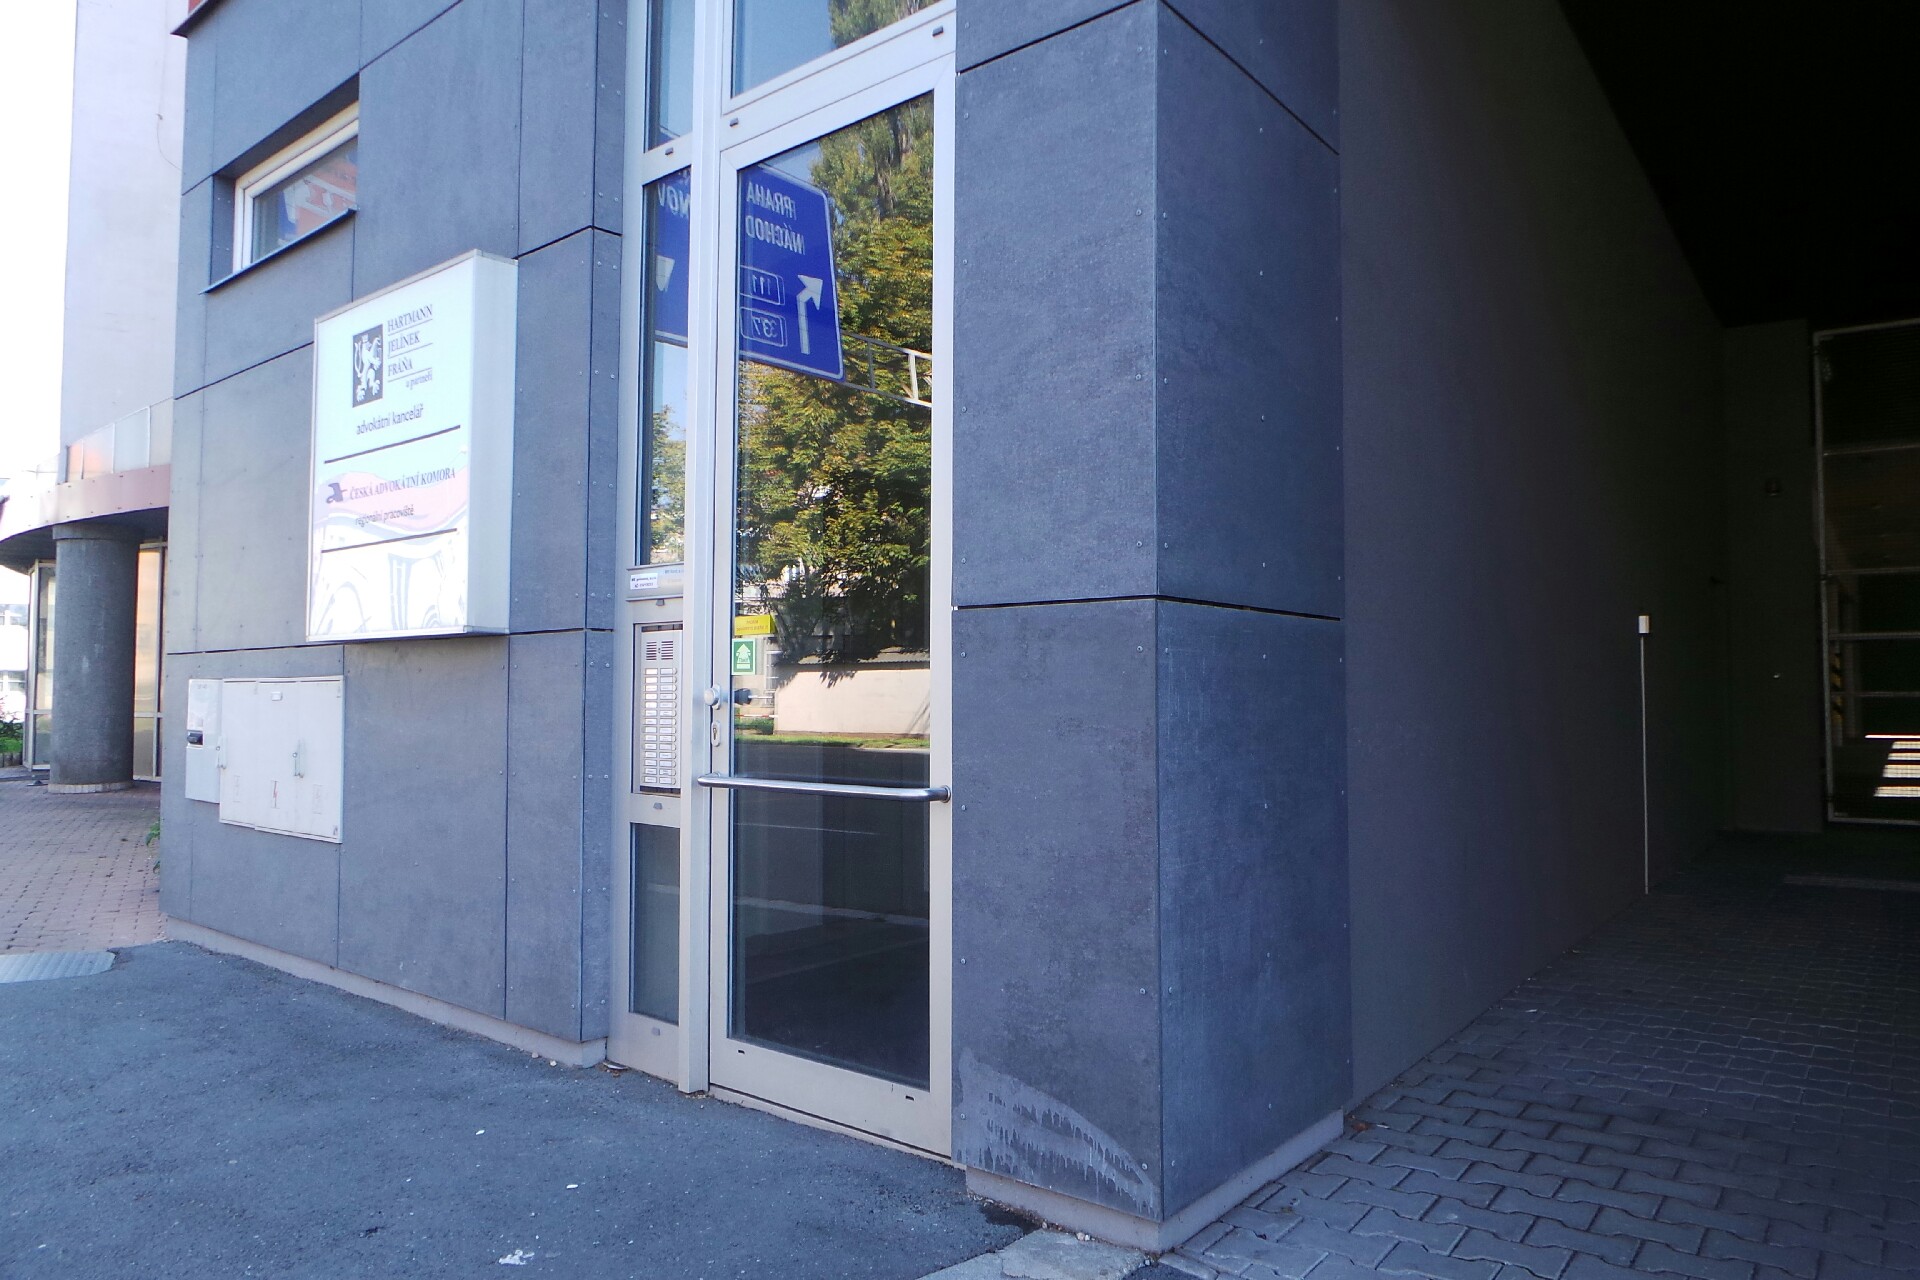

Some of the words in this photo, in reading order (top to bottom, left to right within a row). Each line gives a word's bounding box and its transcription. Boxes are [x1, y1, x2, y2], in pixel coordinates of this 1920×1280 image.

[387, 304, 433, 332] HARTMANN
[387, 331, 421, 358] JELÍNEK
[356, 412, 391, 435] advokátní
[392, 403, 424, 425] kancelář
[350, 482, 374, 500] ČESKÁ
[374, 471, 420, 496] ADVOKÁTNÍ
[420, 467, 456, 486] KOMORA
